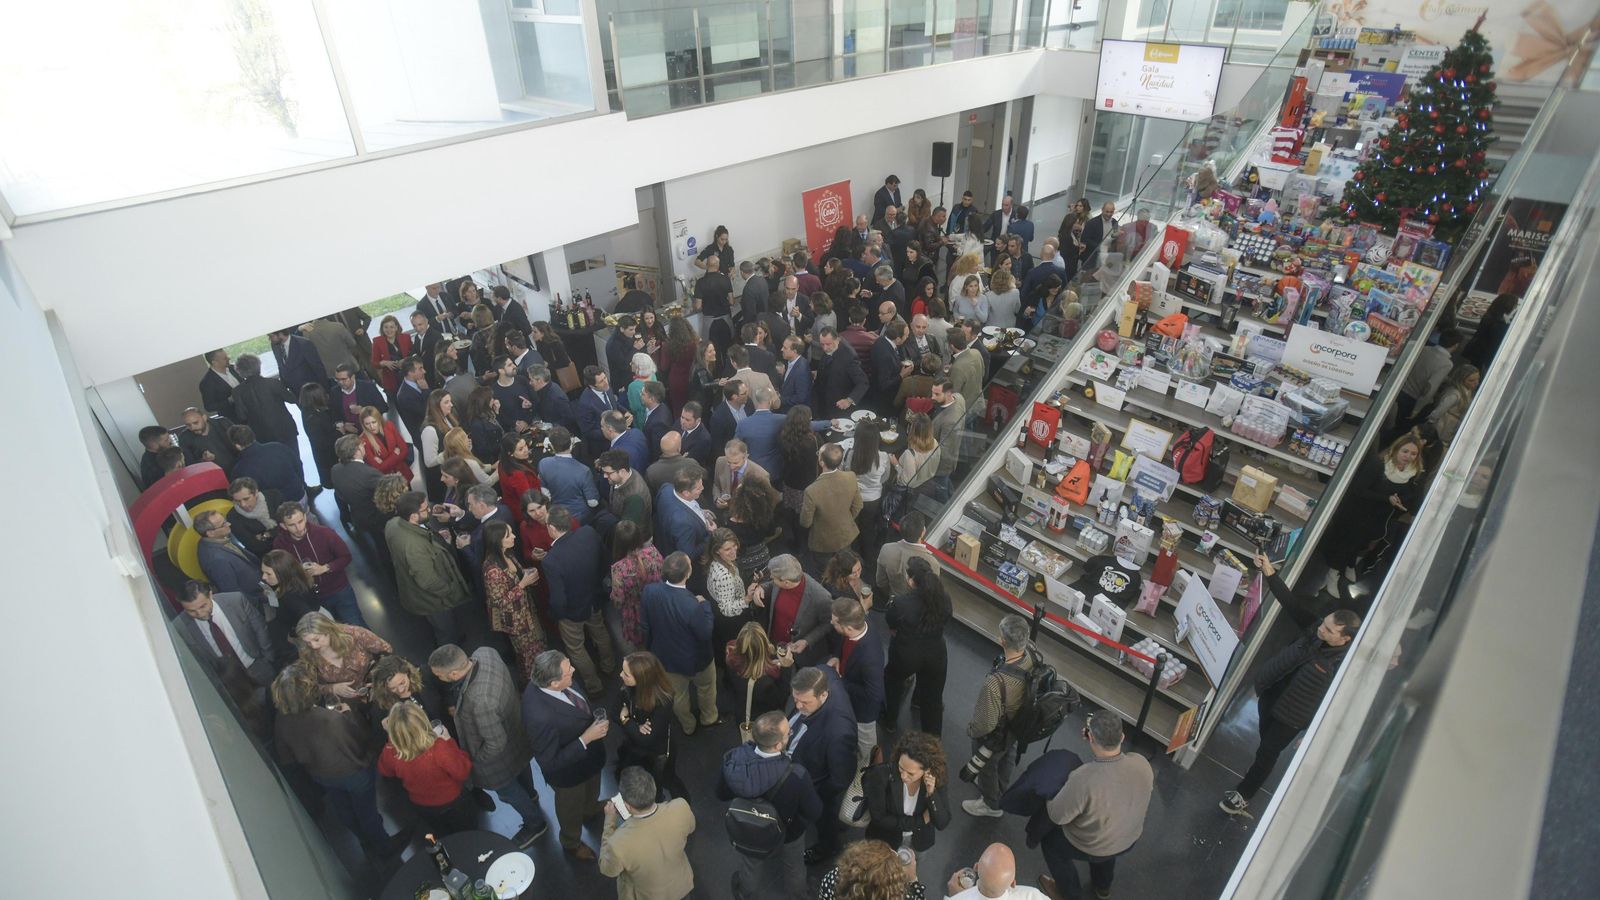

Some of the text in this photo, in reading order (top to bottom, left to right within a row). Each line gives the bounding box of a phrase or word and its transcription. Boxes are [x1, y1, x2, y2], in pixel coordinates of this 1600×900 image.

[1141, 64, 1160, 73] Gala
[1139, 73, 1175, 90] Navidad
[1313, 343, 1358, 360] incorpora
